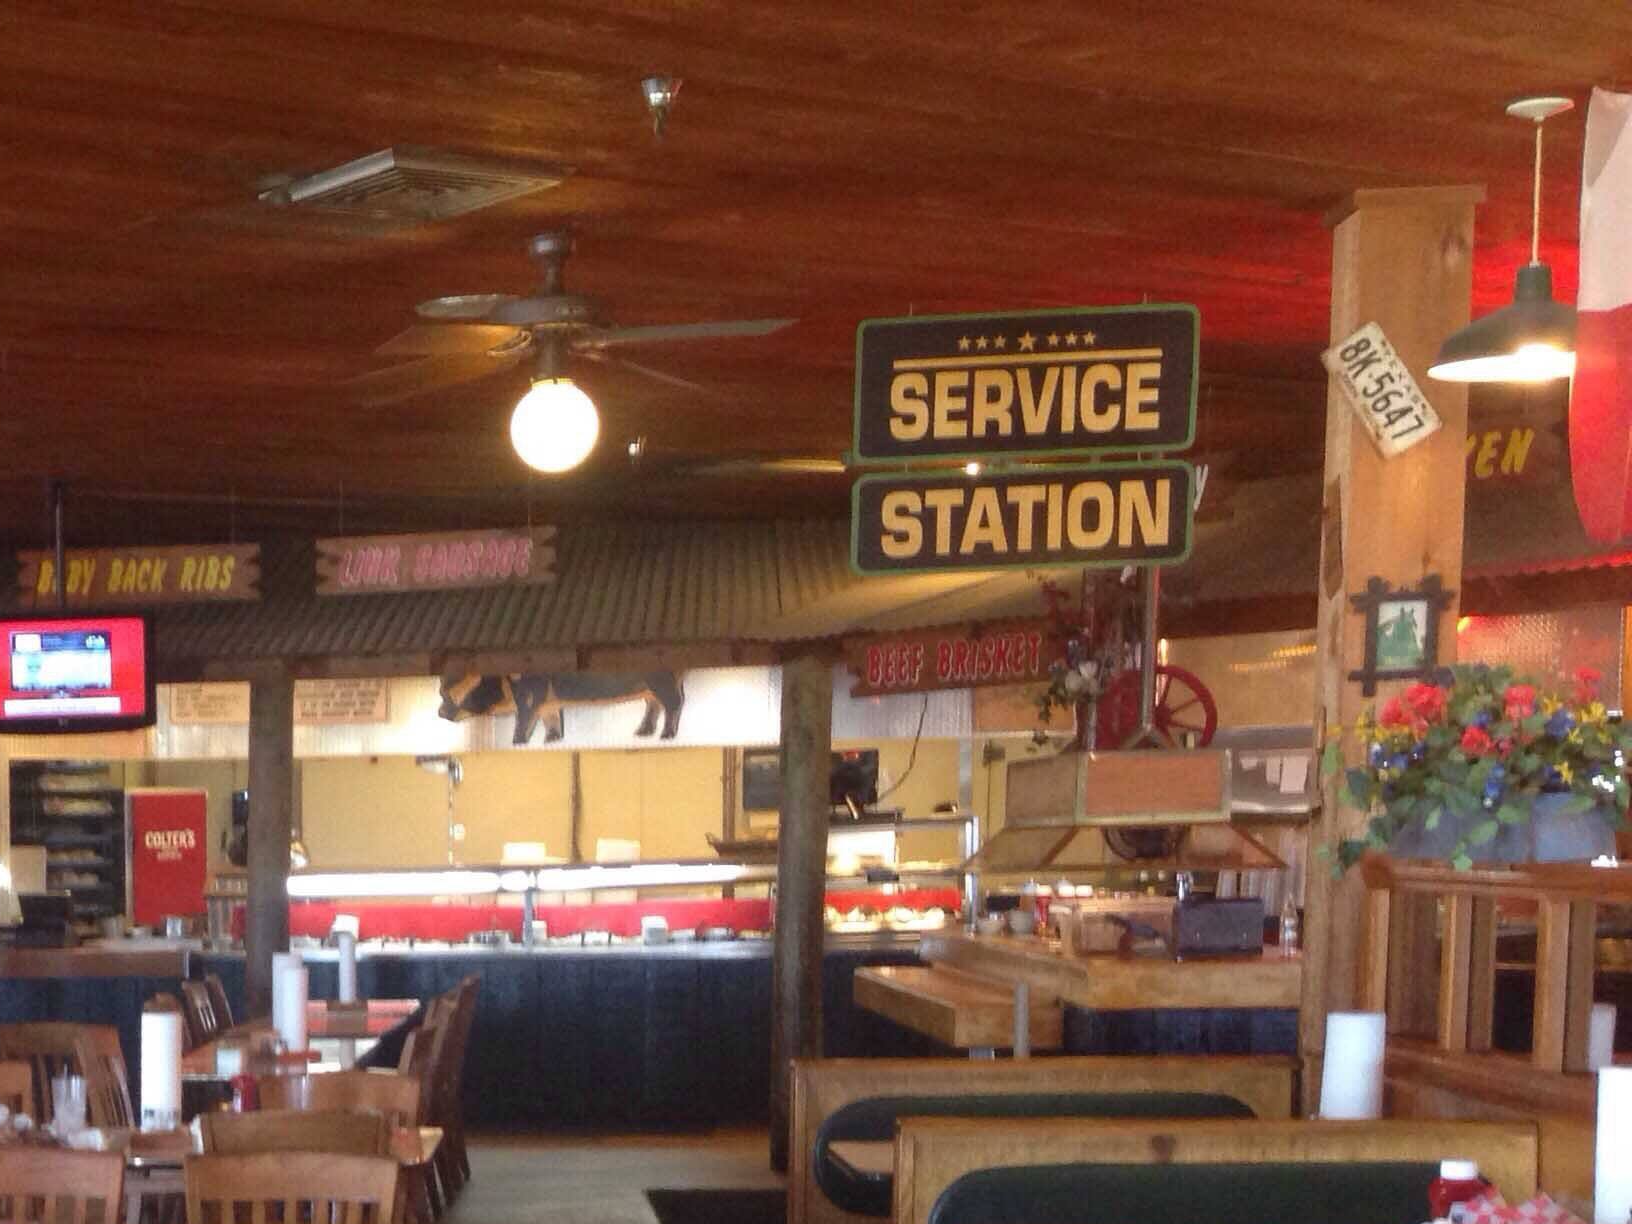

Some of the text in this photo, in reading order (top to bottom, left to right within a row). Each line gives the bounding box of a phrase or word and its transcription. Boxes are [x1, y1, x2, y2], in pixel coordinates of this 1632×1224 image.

[889, 362, 1163, 442] SERVICE
[880, 479, 1171, 560] STATION
[36, 554, 235, 595] BBY BACK RIBS
[414, 536, 530, 582] SAUSAGE
[868, 632, 1042, 687] BEEF BRISKET
[144, 828, 196, 849] COLTER'S
